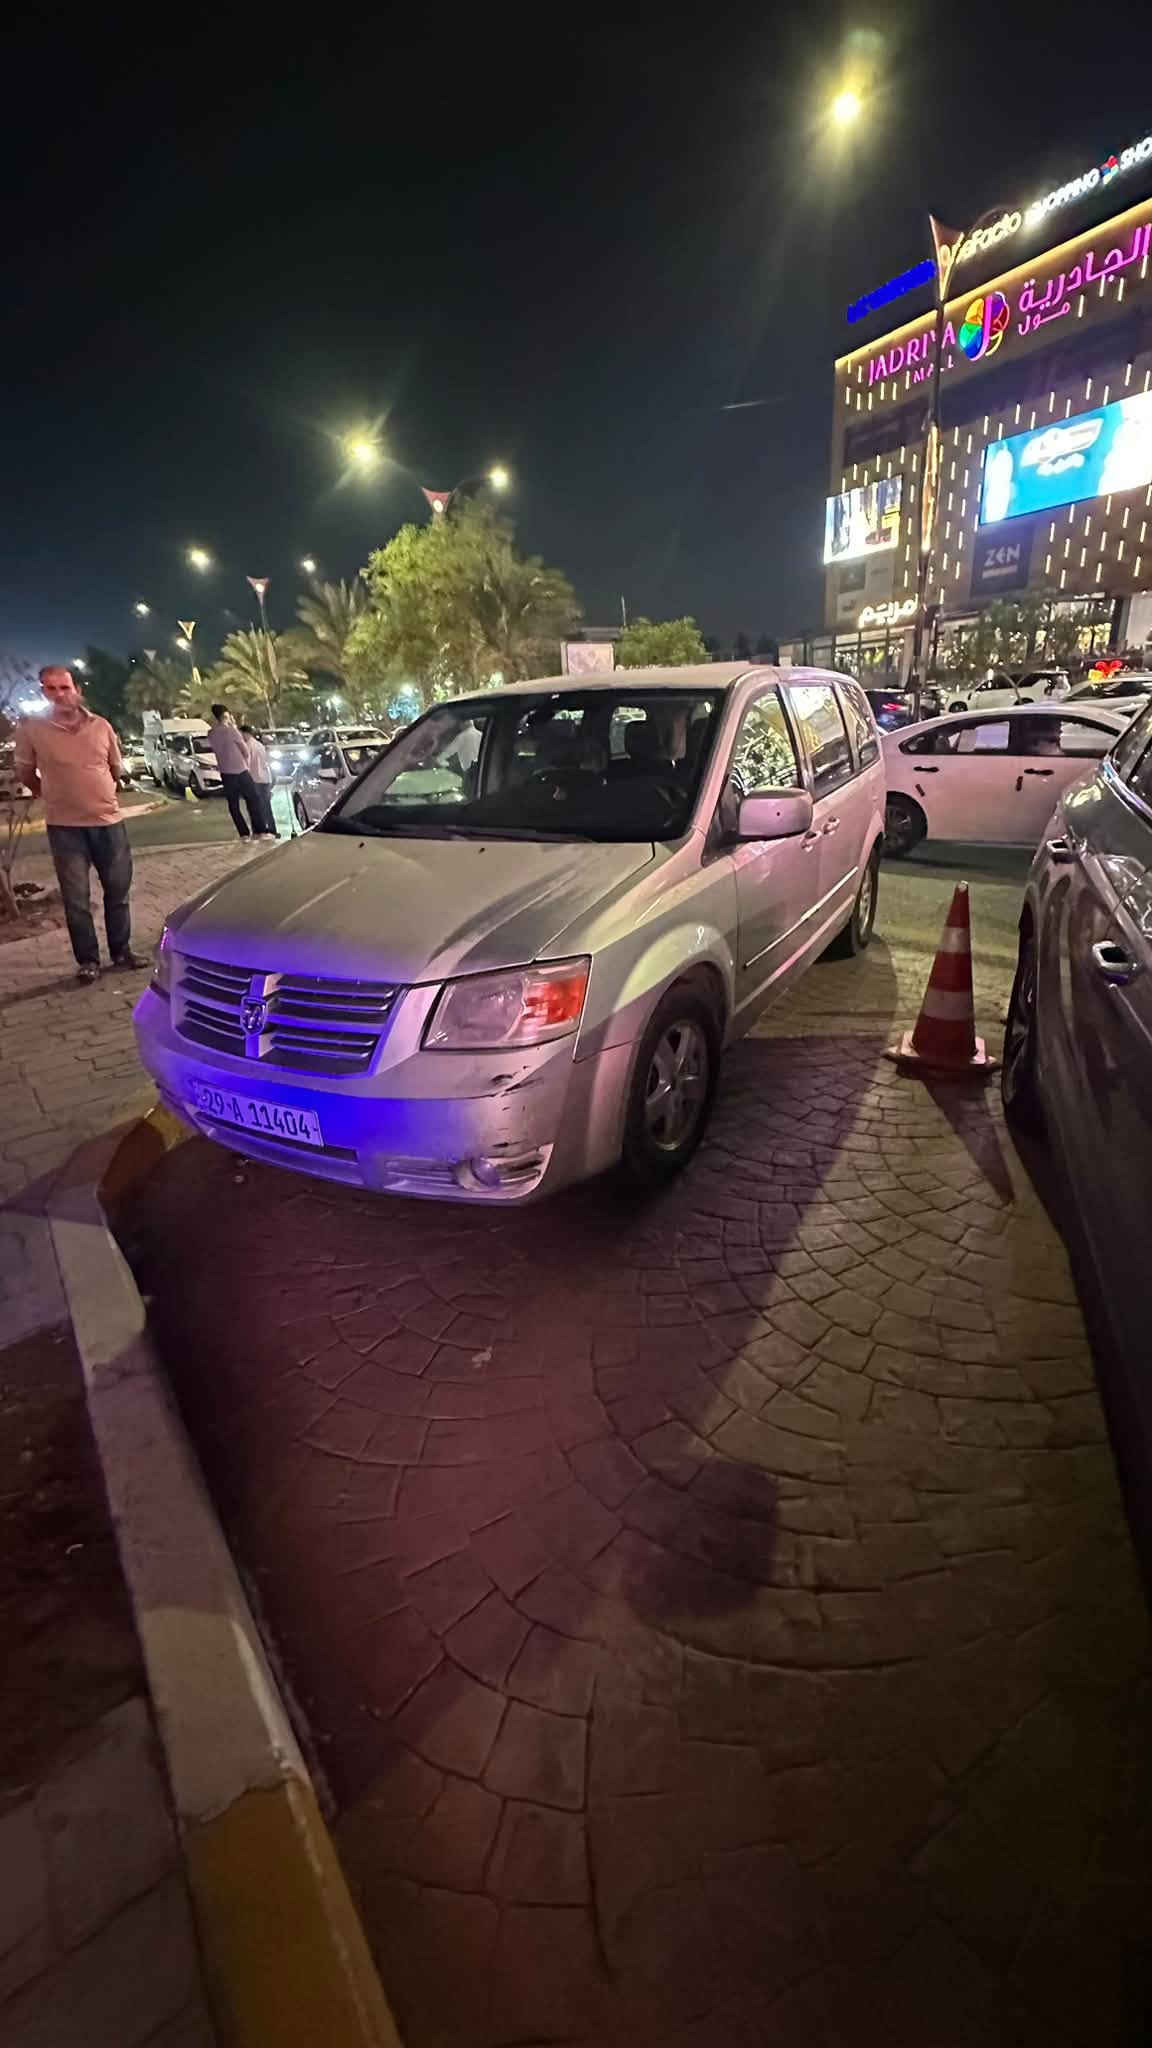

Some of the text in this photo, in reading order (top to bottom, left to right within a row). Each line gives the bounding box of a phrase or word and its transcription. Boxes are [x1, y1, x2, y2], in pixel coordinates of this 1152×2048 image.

[1019, 223, 1152, 312] الجادرية
[1018, 302, 1071, 335] مول
[913, 354, 954, 383] ML
[248, 1102, 311, 1140] 11404
